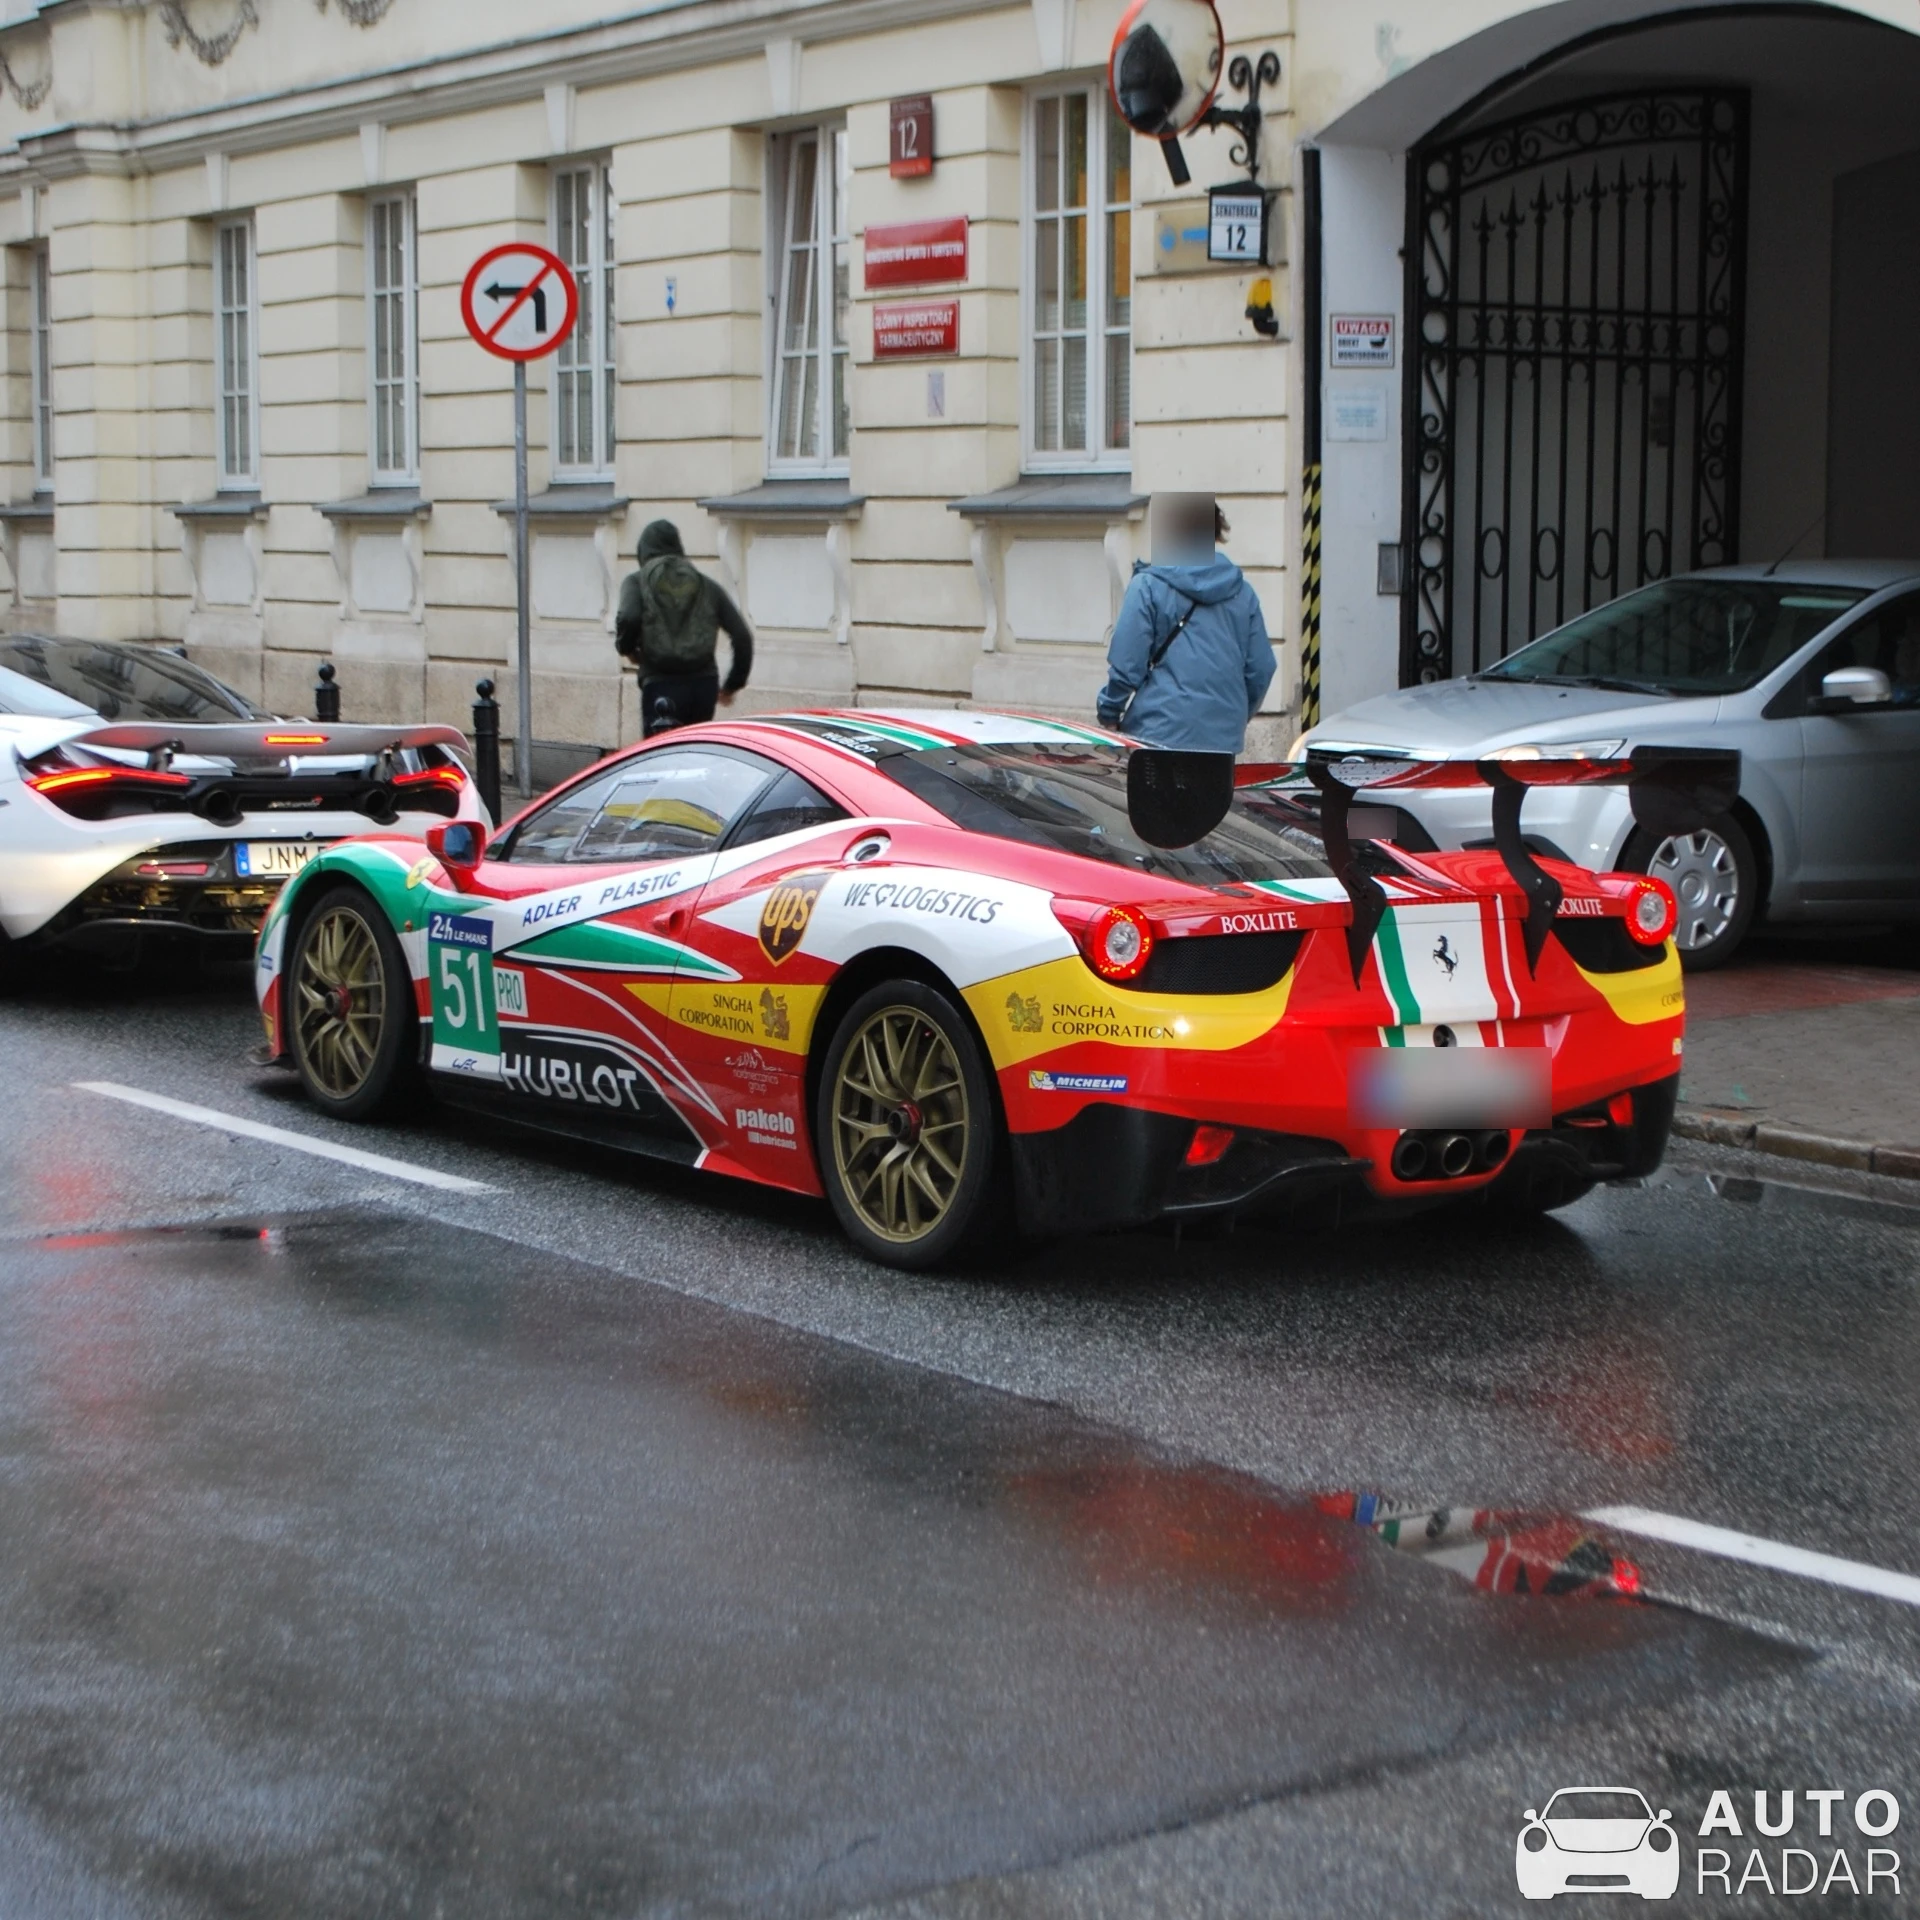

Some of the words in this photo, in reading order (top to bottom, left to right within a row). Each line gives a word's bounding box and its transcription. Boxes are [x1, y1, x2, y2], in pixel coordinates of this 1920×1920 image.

[899, 117, 918, 159] 12
[1215, 205, 1258, 218] SENATORSKA
[1226, 224, 1246, 251] 12
[1339, 322, 1388, 335] UWAGA
[262, 846, 309, 870] JNM
[522, 895, 582, 927] ADLER
[599, 871, 681, 905] PLASTIC
[890, 884, 1003, 924] LOGISTICS
[763, 887, 817, 947] ups
[1220, 911, 1298, 934] BOXLITE
[441, 947, 485, 1032] 51
[497, 971, 522, 1011] PRO
[713, 993, 753, 1014] SINGHA
[1052, 1003, 1116, 1019] SINGHA
[679, 1007, 754, 1035] CORPORATION
[1051, 1021, 1175, 1039] CORPORATION
[501, 1051, 640, 1110] HUBLOT
[1056, 1075, 1127, 1089] MICHELIN
[736, 1107, 795, 1135] pakelo
